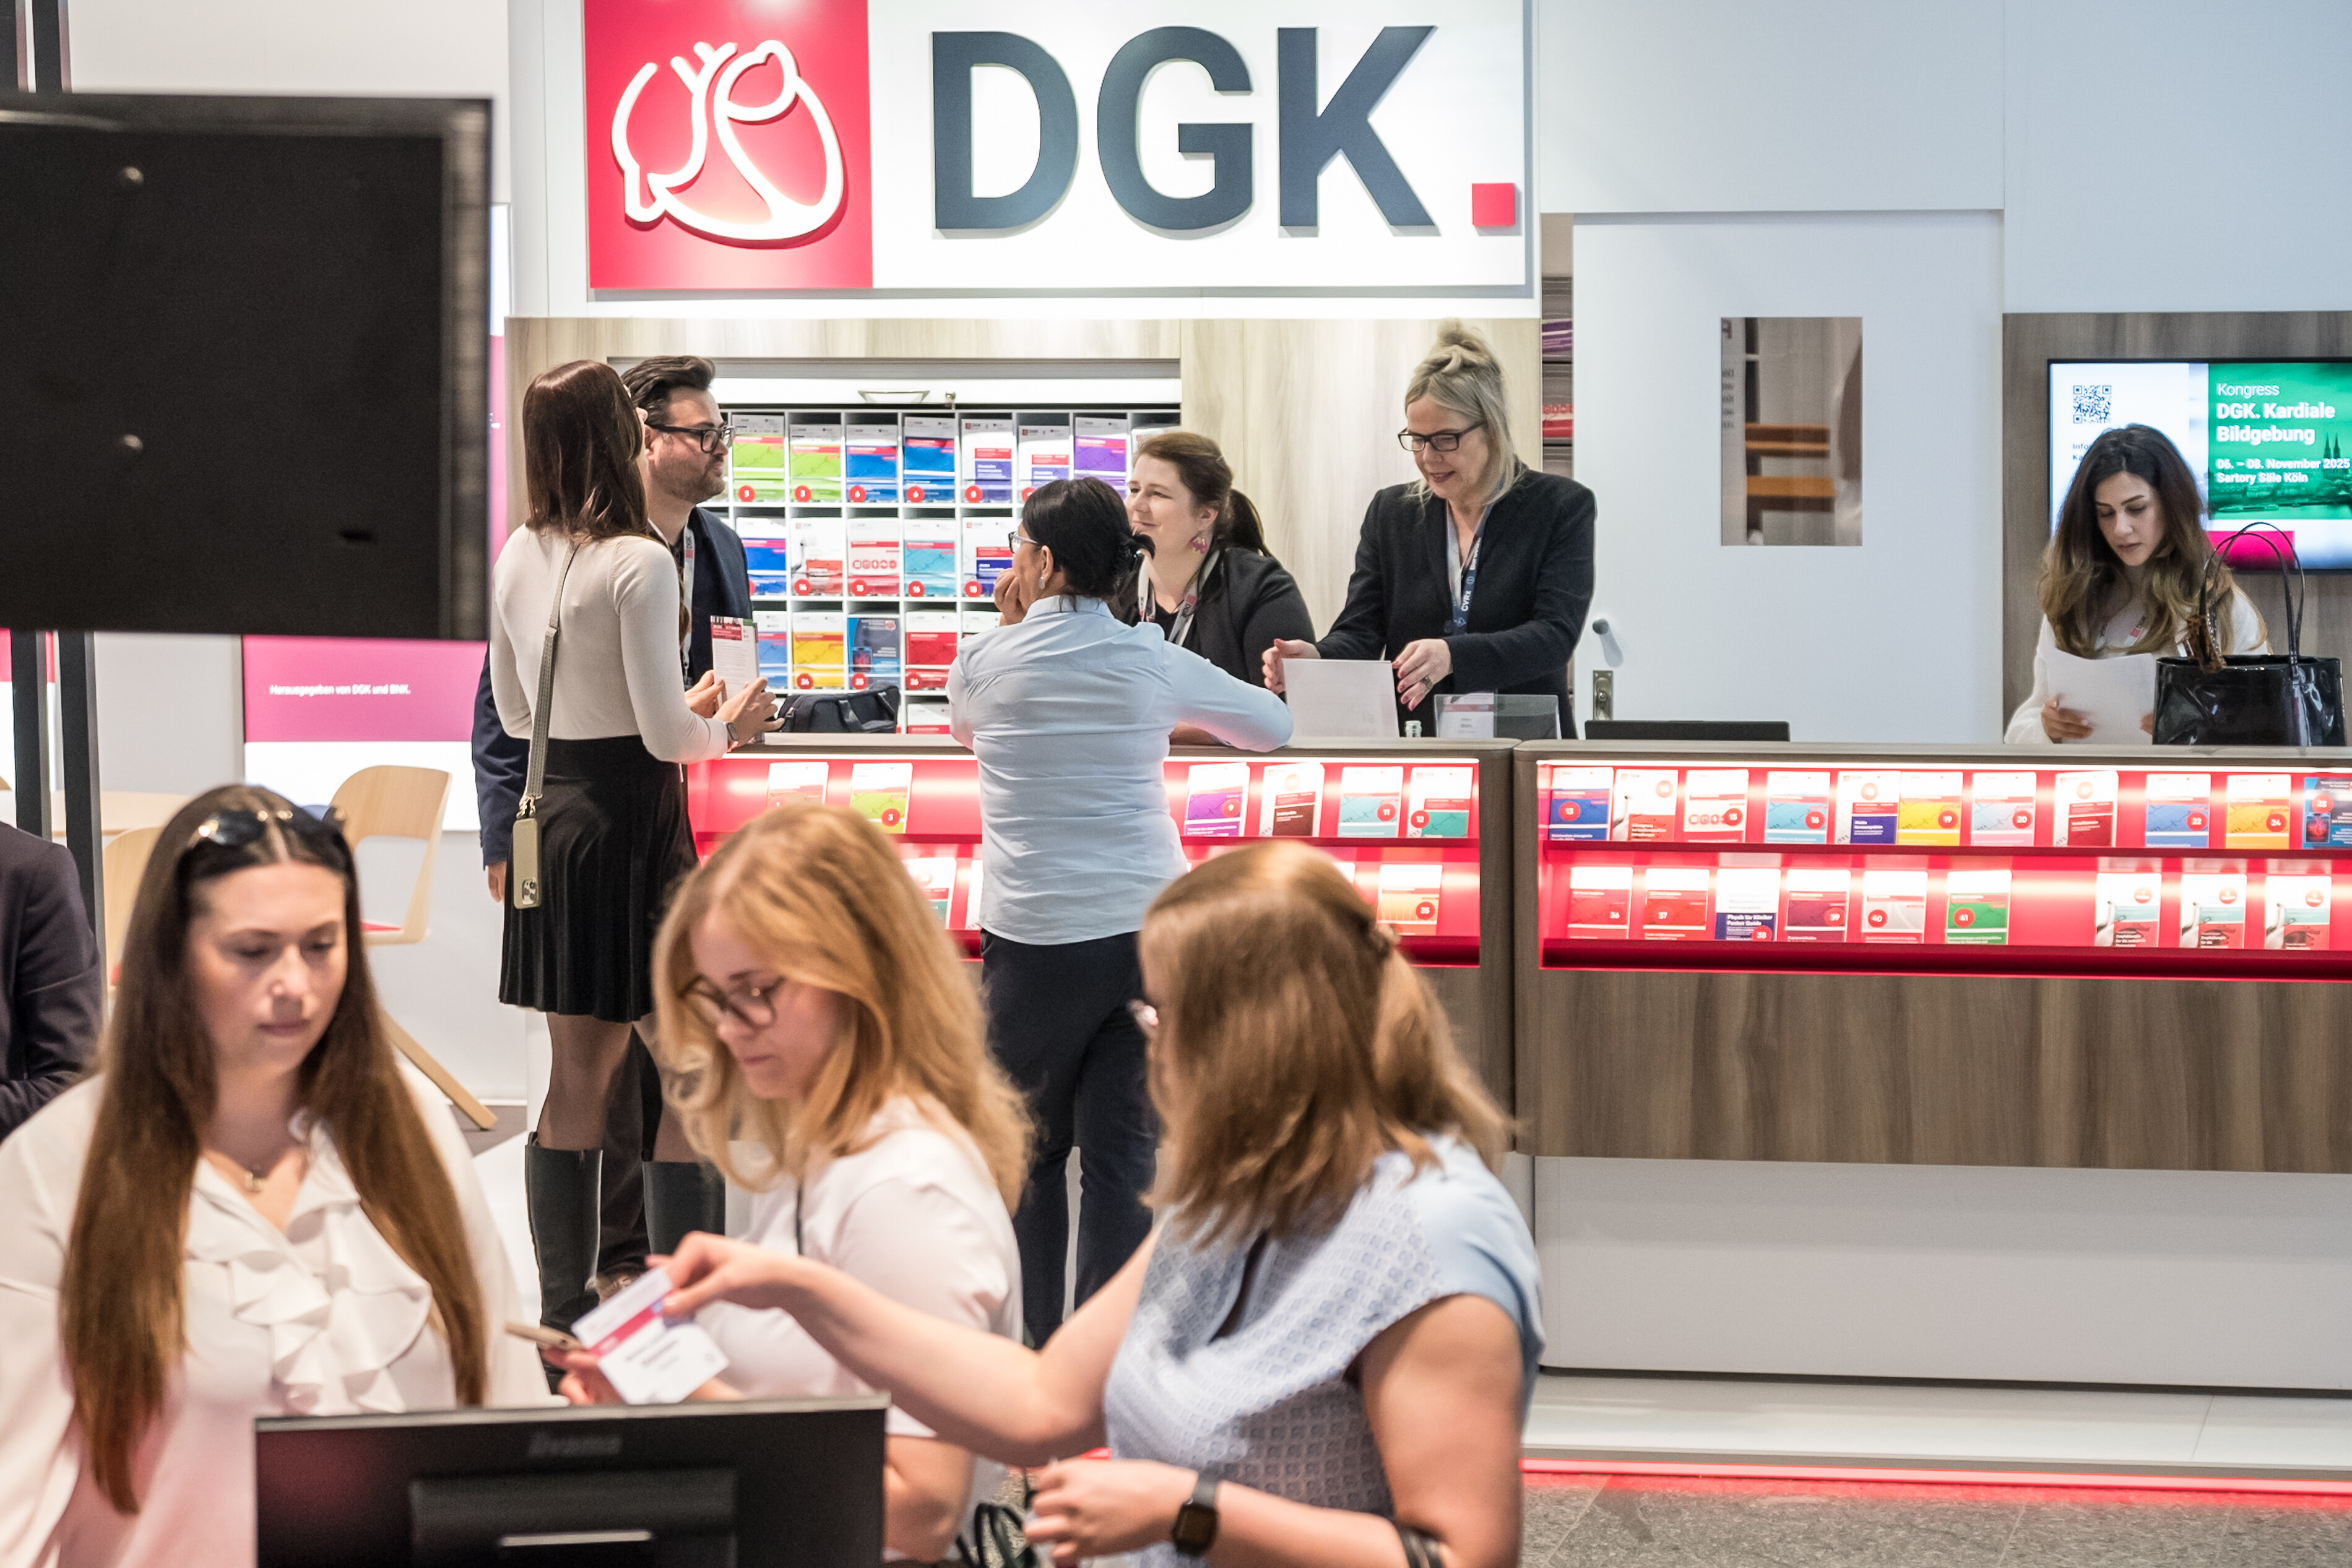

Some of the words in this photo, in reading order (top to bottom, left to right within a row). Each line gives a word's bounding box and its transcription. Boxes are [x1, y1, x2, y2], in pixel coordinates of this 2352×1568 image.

[2217, 383, 2280, 400] Kongress
[2216, 402, 2261, 420] DGK.
[2263, 401, 2336, 420] Kardiale
[2216, 425, 2315, 446] Bildgebung
[2216, 459, 2234, 470] 06.
[2247, 459, 2265, 470] 08.
[2267, 459, 2322, 470] November
[2323, 458, 2350, 470] 2025
[2216, 472, 2257, 485] Sartory
[2258, 471, 2283, 483] Säle
[2284, 471, 2309, 483] Köln
[1461, 590, 1472, 612] CVRx
[270, 684, 335, 697] Herausgegeben
[335, 686, 352, 695] von
[352, 684, 371, 695] DGK
[373, 684, 389, 695] und
[2316, 799, 2328, 808] 25
[1382, 808, 1391, 816] 11
[1565, 807, 1575, 816] 13
[1416, 815, 1425, 823] 12
[1728, 812, 1739, 821] 15
[1810, 816, 1820, 824] 16
[1943, 815, 1953, 824] 19
[2017, 815, 2028, 824] 20
[2191, 817, 2203, 825] 22
[2270, 818, 2282, 827] 24
[1420, 906, 1431, 915] 35
[1609, 910, 1620, 920] 36
[1658, 911, 1669, 920] 37
[1830, 913, 1841, 922] 39
[1871, 914, 1883, 923] 40
[1958, 913, 1969, 922] 41
[1756, 931, 1767, 939] 38
